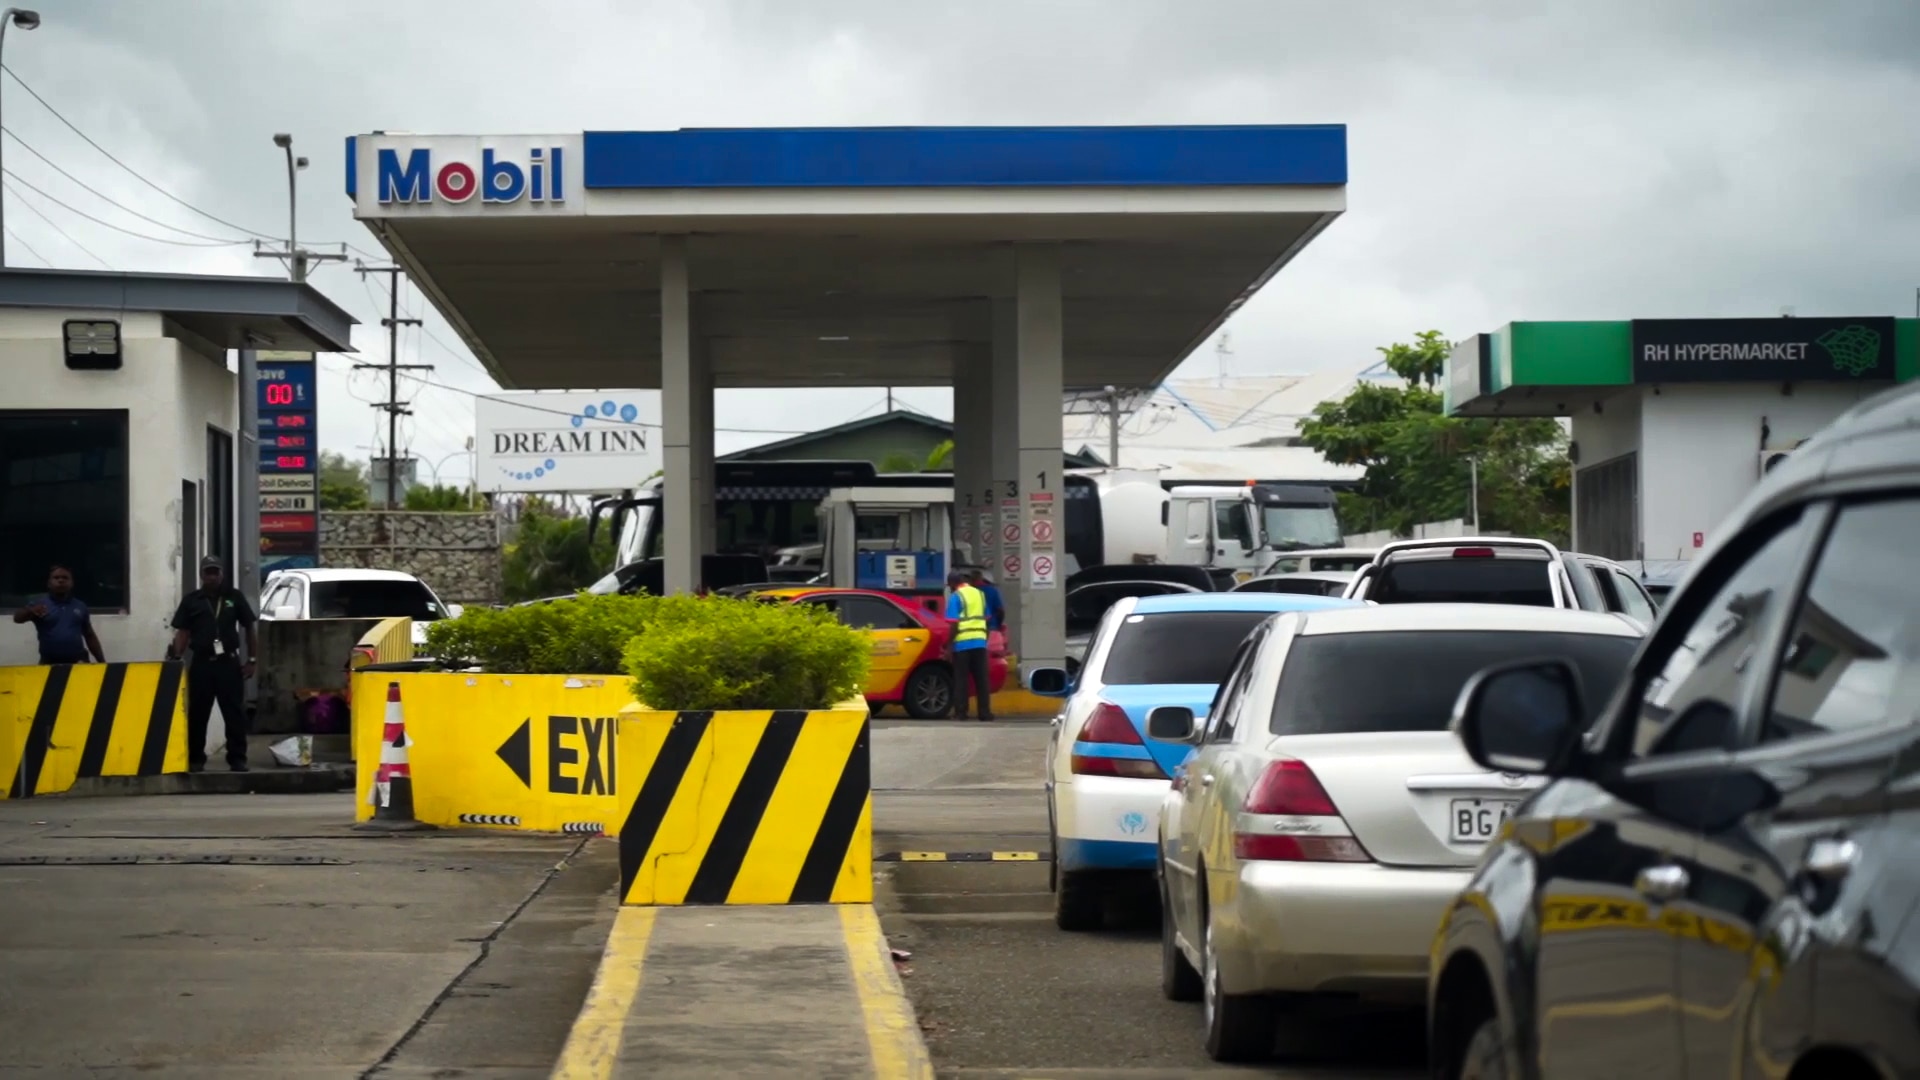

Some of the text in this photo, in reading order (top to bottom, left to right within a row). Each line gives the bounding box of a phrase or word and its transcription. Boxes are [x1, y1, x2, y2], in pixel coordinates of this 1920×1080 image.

[378, 148, 564, 203] Mobil
[1644, 342, 1809, 361] RH HYPERMARKET
[494, 430, 647, 454] DREAM INN
[1007, 481, 1018, 498] 3
[1037, 471, 1046, 489] 1
[548, 715, 620, 796] EXI
